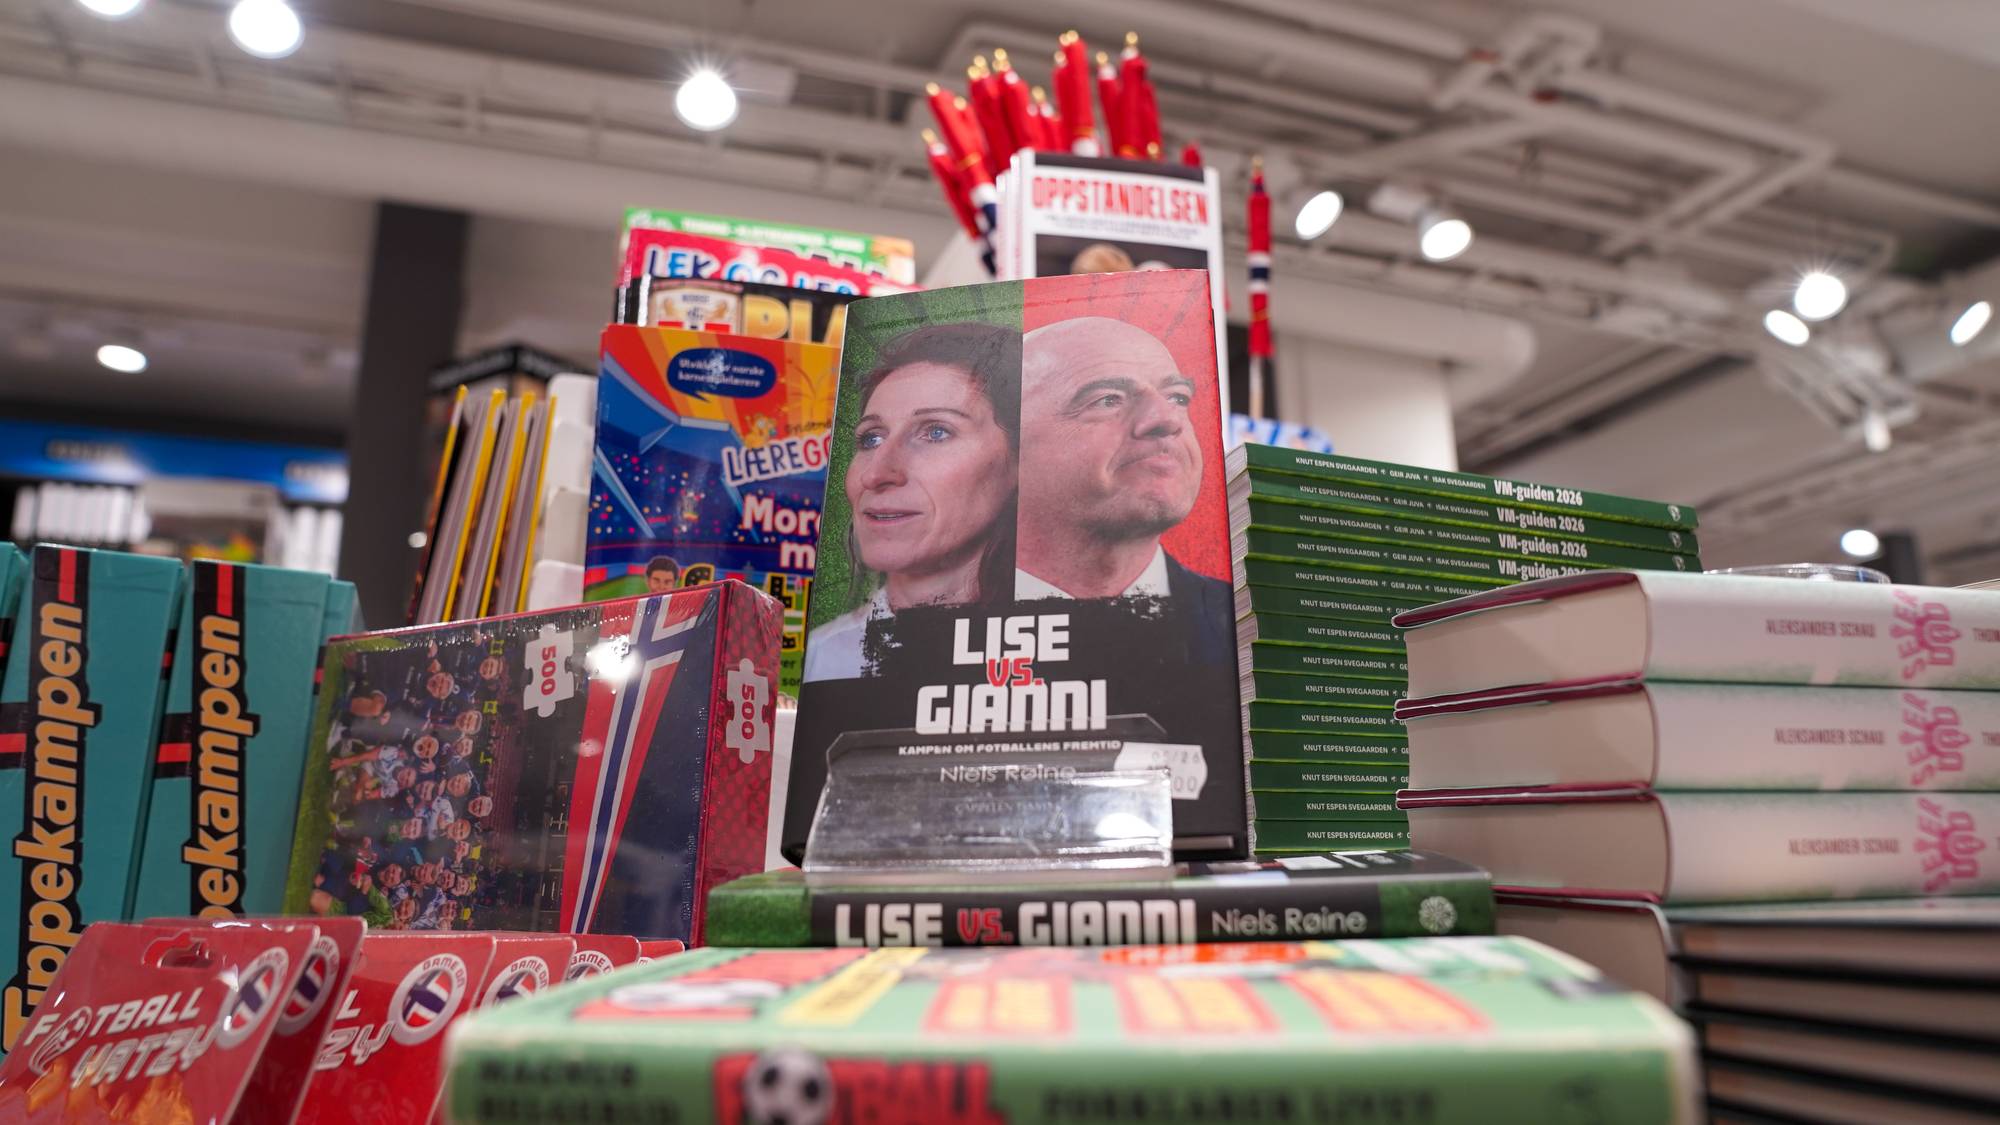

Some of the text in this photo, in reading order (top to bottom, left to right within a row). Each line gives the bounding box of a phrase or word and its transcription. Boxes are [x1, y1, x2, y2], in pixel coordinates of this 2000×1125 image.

[1032, 177, 1208, 225] OPPSTANDELSEN
[1296, 456, 1583, 507] KNUT ESPEN SVEGAARDEN GEIR JUVA ISAK SVEGAARDEN VM-guiden 2026
[1300, 485, 1318, 494] KNUT
[1318, 487, 1338, 497] ESPEN
[1339, 490, 1382, 502] SVEGAARDEN
[1408, 500, 1424, 508] JUVA
[1435, 503, 1450, 512] ISAK
[1450, 505, 1490, 517] SVEGAARDEN
[1497, 507, 1557, 530] VM-guiden
[1558, 515, 1585, 533] 2026
[1299, 514, 1317, 523] KNUT
[1318, 516, 1338, 525] ESPEN
[1340, 519, 1382, 531] SVEGAARDEN
[1450, 532, 1490, 543] SVEGAARDEN
[1498, 534, 1559, 556] VM-guiden
[1560, 541, 1588, 559] 2026
[1297, 543, 1316, 551] KNUT
[1316, 544, 1336, 553] ESPEN
[1338, 547, 1380, 558] SVEGAARDEN
[1392, 552, 1406, 561] GEIR
[1435, 557, 1450, 565] ISAK
[1450, 559, 1490, 570] SVEGAARDEN
[1295, 572, 1314, 580] KNUT
[1314, 574, 1335, 582] ESPEN
[1335, 576, 1378, 587] SVEGAARDEN
[1390, 581, 1406, 589] GEIR
[1406, 583, 1422, 591] JUVA
[1434, 585, 1448, 593] ISAK
[1300, 599, 1318, 607] KNUT
[1319, 600, 1340, 609] ESPEN
[1340, 602, 1384, 613] SVEGAARDEN
[1308, 627, 1391, 641] KNUT ESPEN SVEGAARDEN
[1765, 618, 1837, 637] ALEKSANDER
[1972, 627, 2000, 643] THOM
[952, 613, 1070, 665] LISE
[540, 644, 557, 697] 500
[986, 656, 1045, 687] VS.
[1302, 656, 1321, 664] KNUT
[1322, 657, 1344, 666] ESPEN
[1344, 659, 1387, 669] SVEGAARDEN
[1305, 685, 1390, 697] KNUT ESPEN SVEGAARDEN
[740, 683, 755, 740] 500
[914, 679, 1108, 735] GIANNI
[1301, 714, 1320, 722] KNUT
[1321, 715, 1342, 723] ESPEN
[1342, 716, 1387, 725] SVEGAARDEN
[1774, 727, 1845, 746] ALEKSANDER
[1982, 732, 2000, 748] THO
[898, 740, 1121, 756] KAMPEN OM FOTBALLENS FREMTID
[1303, 744, 1322, 752] KNUT
[1322, 744, 1344, 753] ESPEN
[1344, 745, 1388, 754] SVEGAARDEN
[940, 762, 1077, 783] Niels Røine
[1302, 773, 1320, 781] KNUT
[1321, 774, 1343, 782] ESPEN
[1343, 774, 1388, 783] SVEGAARDEN
[1326, 803, 1348, 811] ESPEN
[1348, 803, 1392, 811] SVEGAARDEN
[1306, 831, 1394, 839] KNUT ESPEN SVEGAARDEN
[834, 899, 1369, 947] LISE VS. GIANNI Niels Røine
[422, 956, 466, 989] GAME ON
[510, 959, 544, 974] GAME
